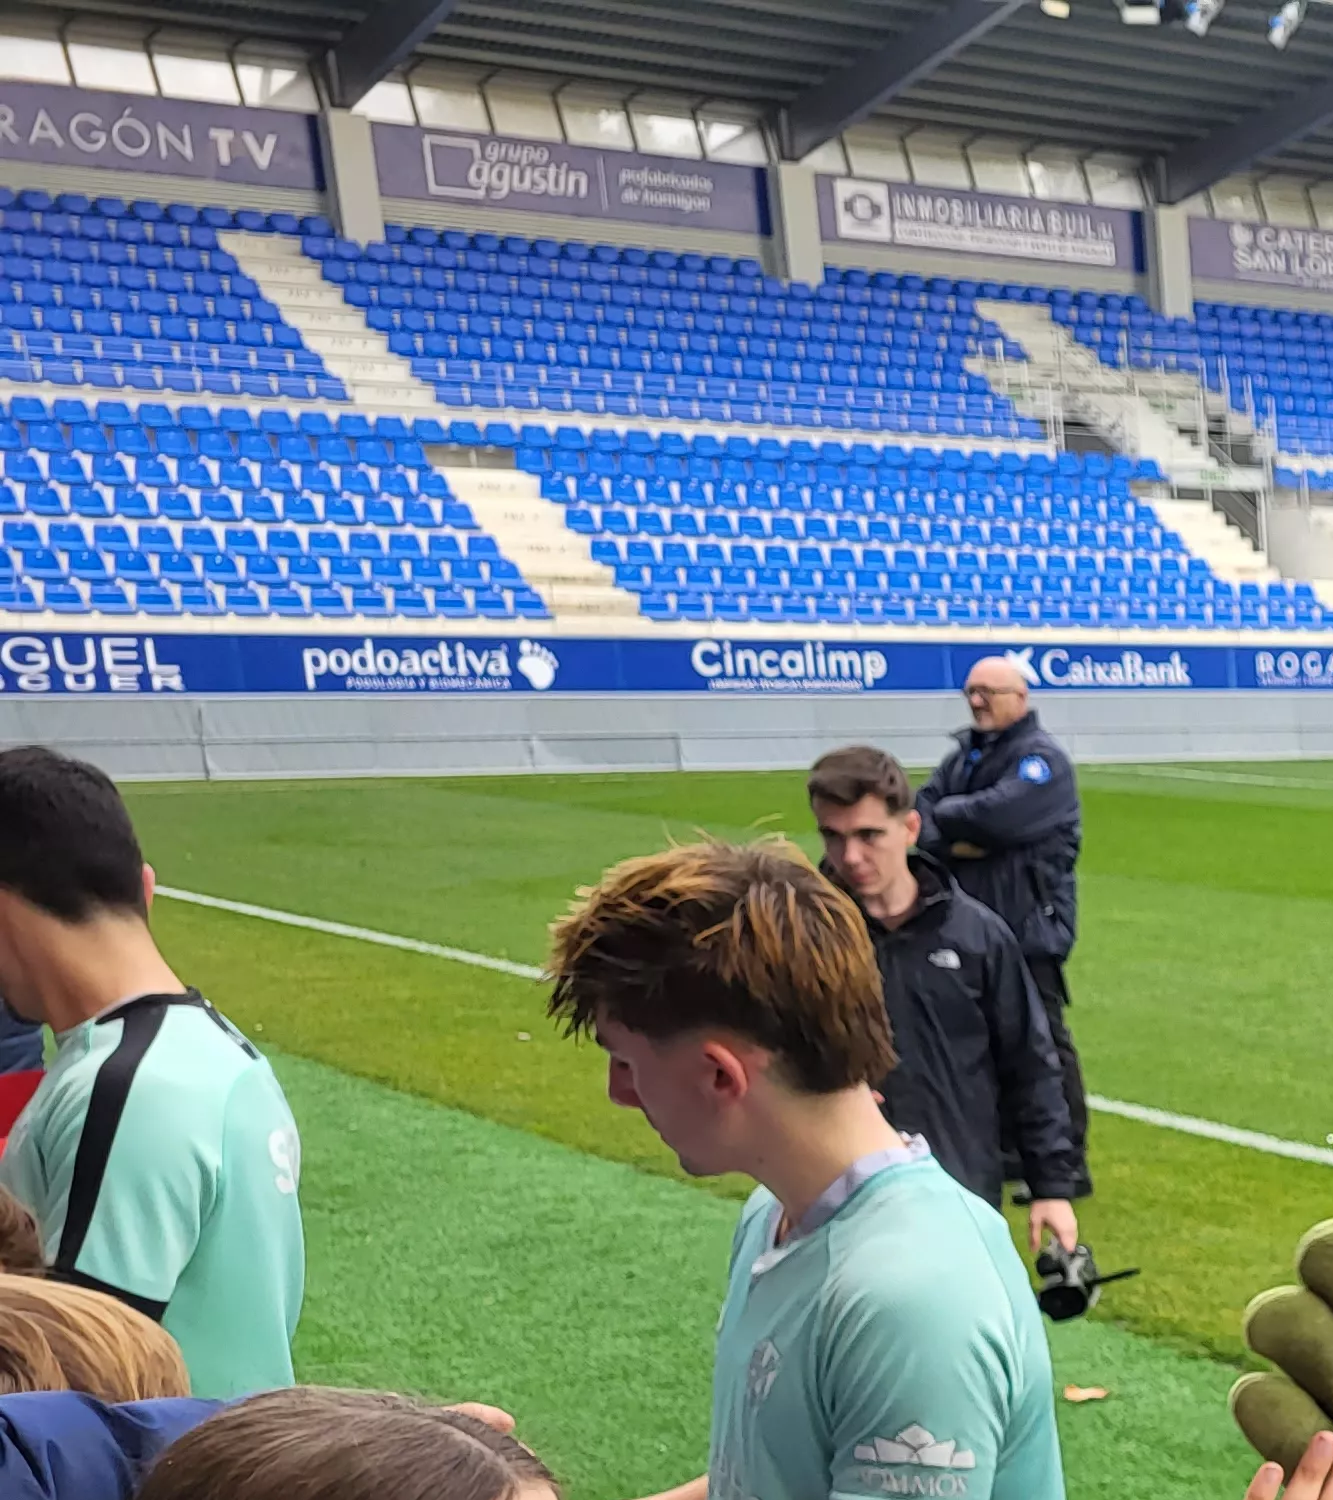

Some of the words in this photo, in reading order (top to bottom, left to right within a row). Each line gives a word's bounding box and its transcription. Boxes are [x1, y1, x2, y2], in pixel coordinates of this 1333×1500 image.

[208, 127, 278, 171] TV
[485, 140, 549, 163] grupo
[894, 192, 1046, 234] INMOBILIARIA
[1233, 250, 1286, 272] SAN
[303, 638, 511, 690] podoactiva
[691, 639, 888, 687] Cincalimp
[1040, 648, 1192, 686] CaixaBank
